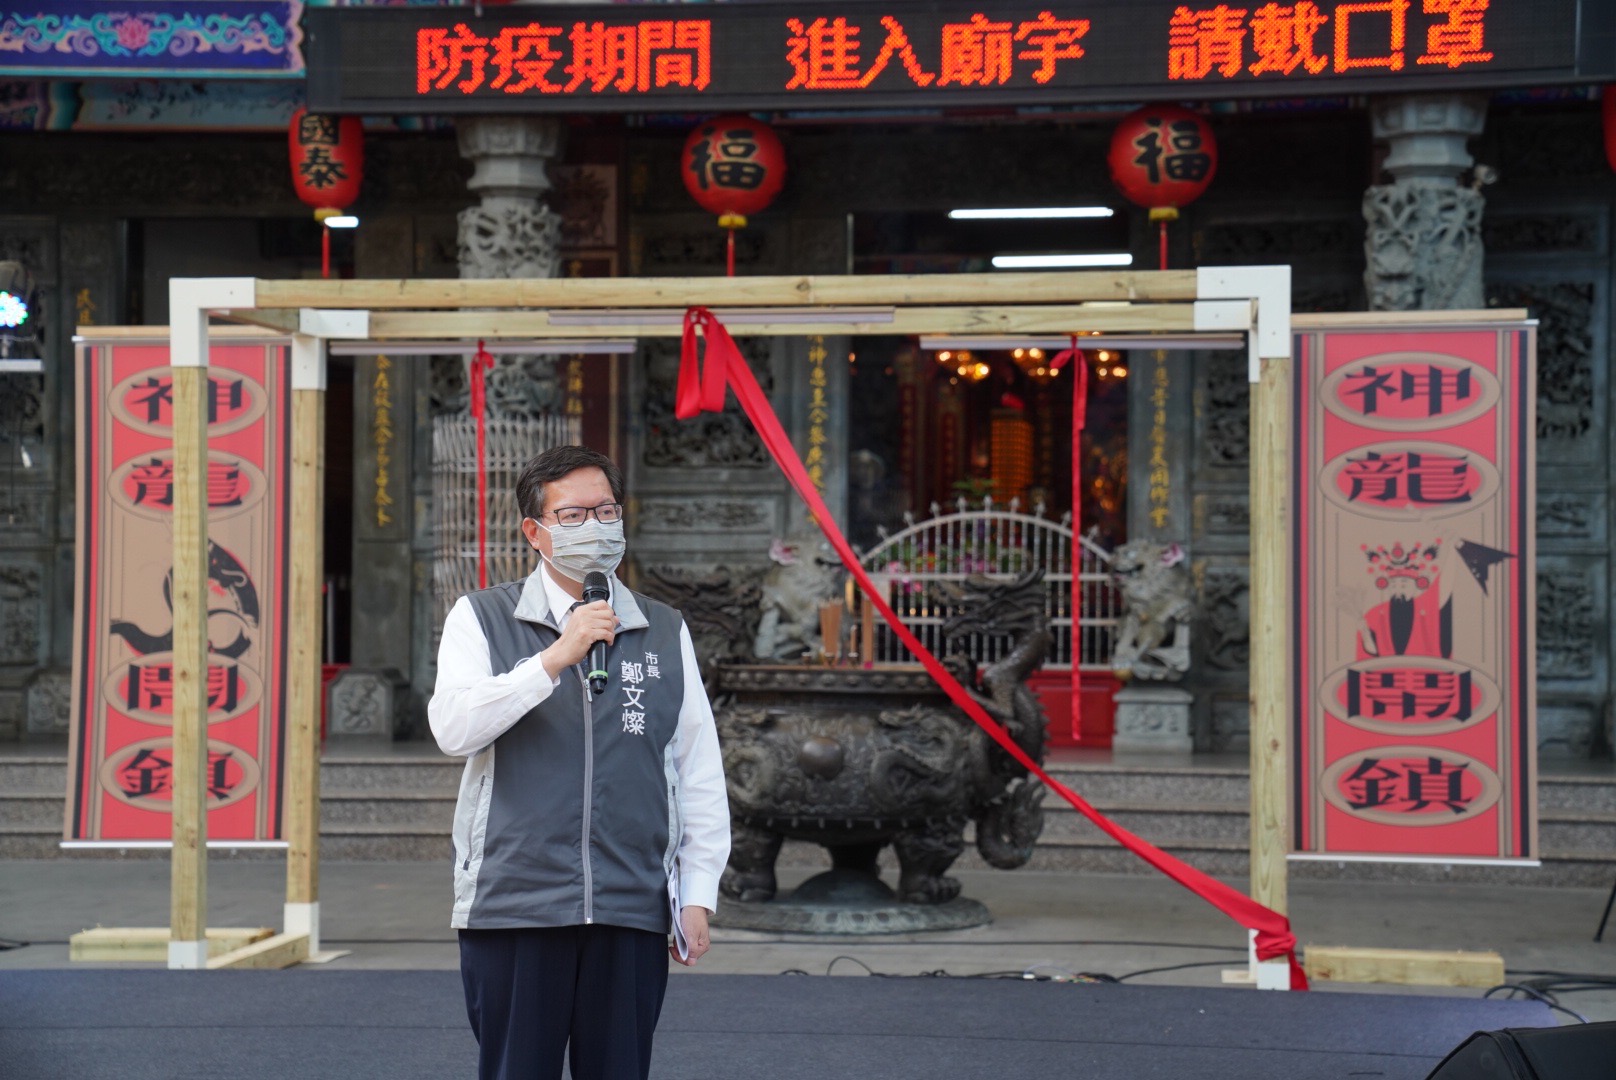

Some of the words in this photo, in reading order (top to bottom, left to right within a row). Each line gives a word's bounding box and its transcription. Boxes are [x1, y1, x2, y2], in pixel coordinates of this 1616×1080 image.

[416, 20, 711, 95] 防疫期間
[785, 11, 1090, 90] 進入廟宇
[1168, 0, 1494, 80] 請戴口罩
[690, 127, 767, 191] 福
[1134, 117, 1211, 185] 福
[620, 660, 646, 736] 鄭文燦
[645, 651, 661, 679] 市長
